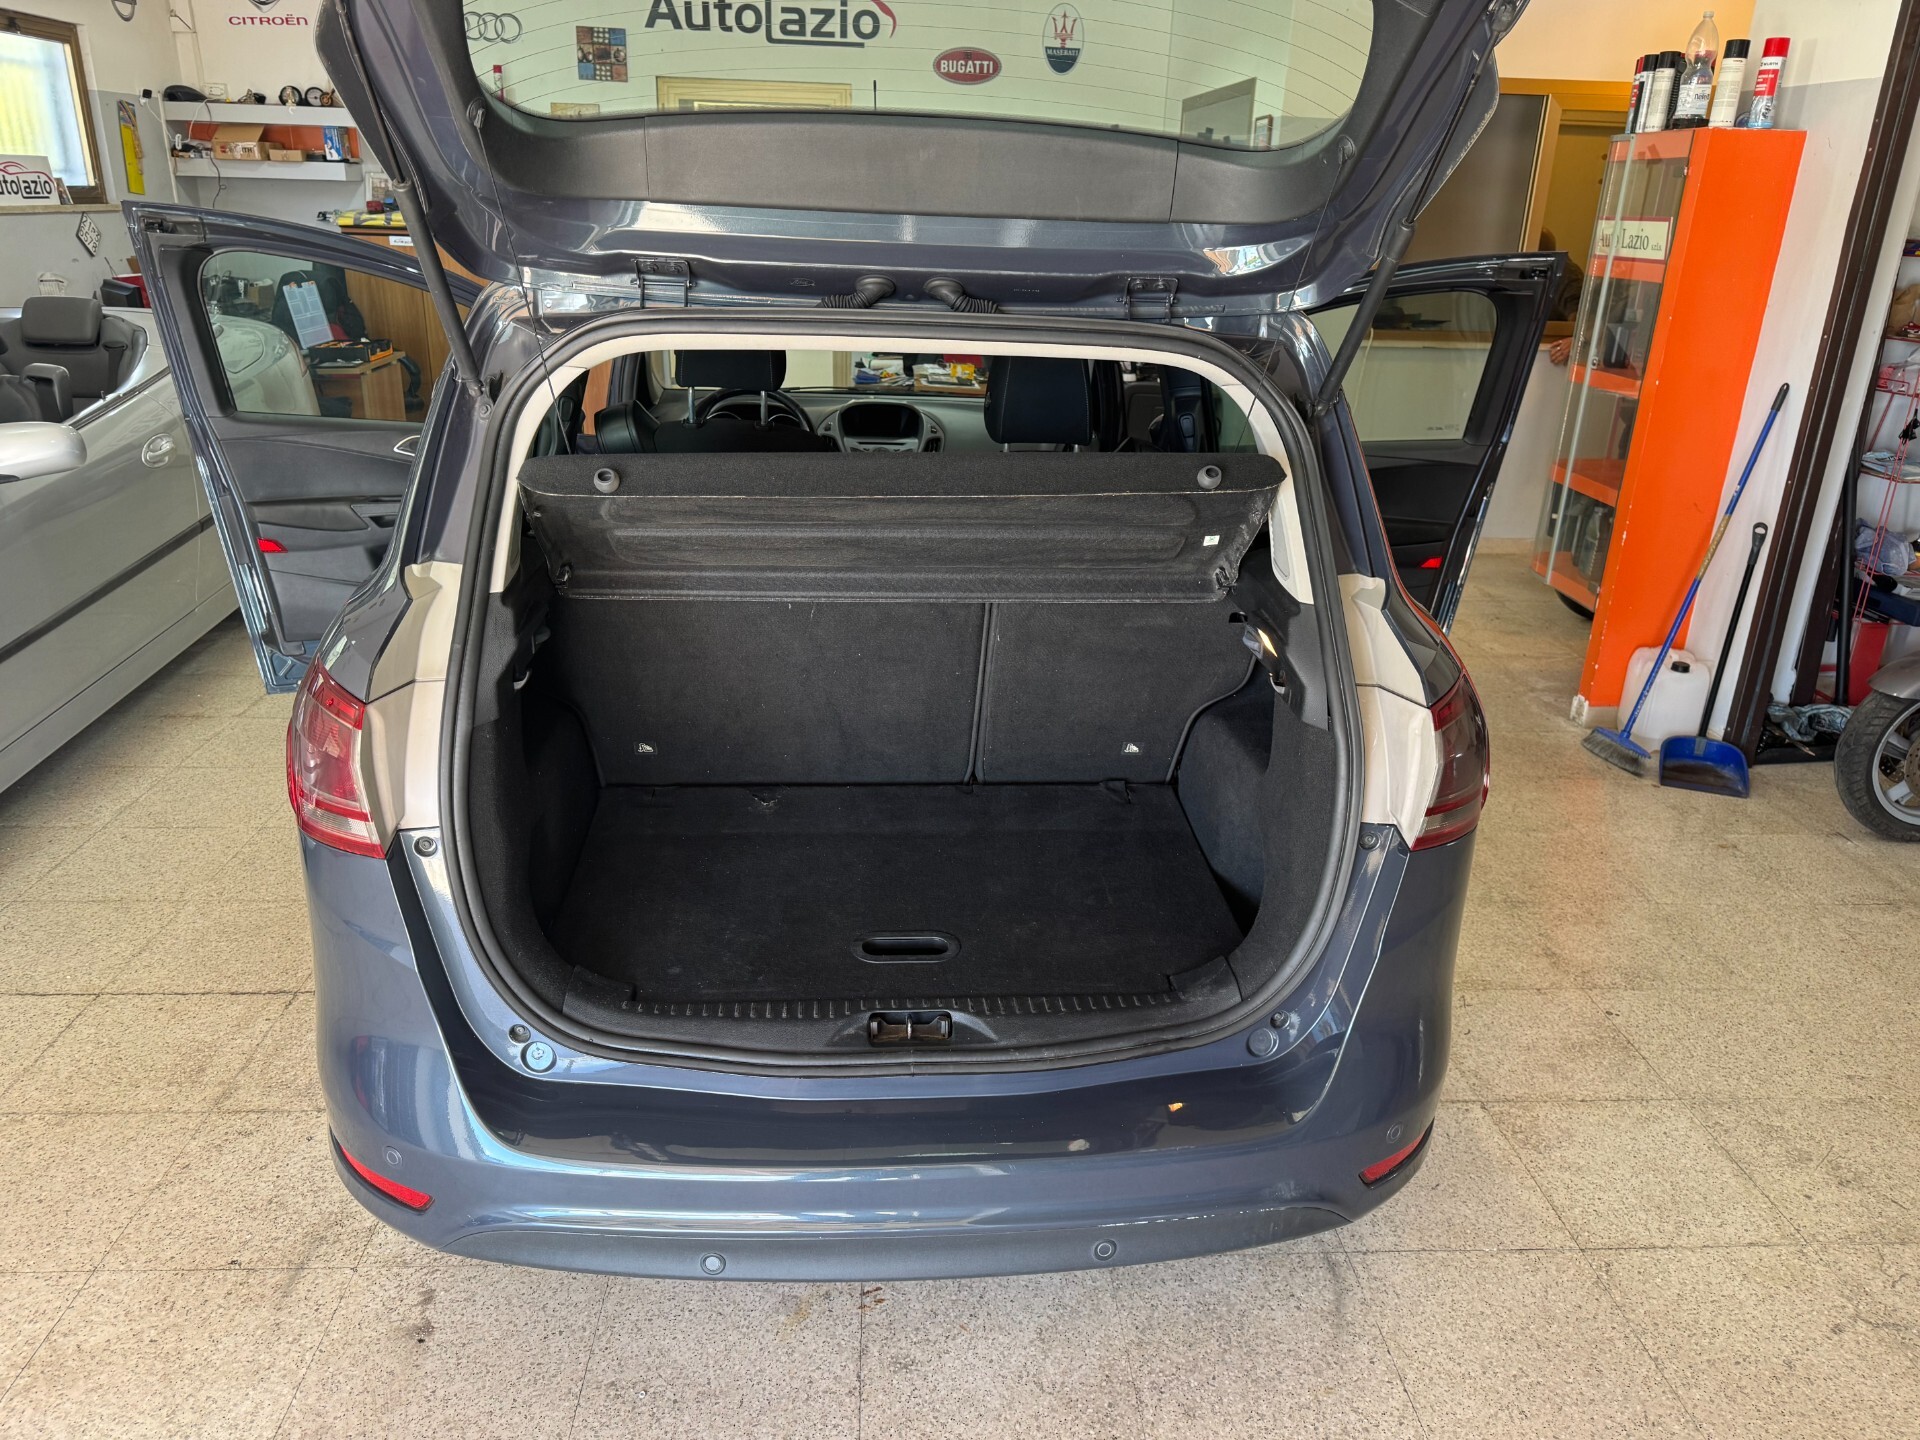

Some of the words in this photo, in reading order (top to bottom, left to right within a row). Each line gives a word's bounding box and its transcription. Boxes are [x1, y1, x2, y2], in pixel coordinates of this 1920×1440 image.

[1046, 47, 1079, 57] MASERATI
[940, 60, 994, 74] BUGATTI
[1621, 228, 1650, 250] Lazio
